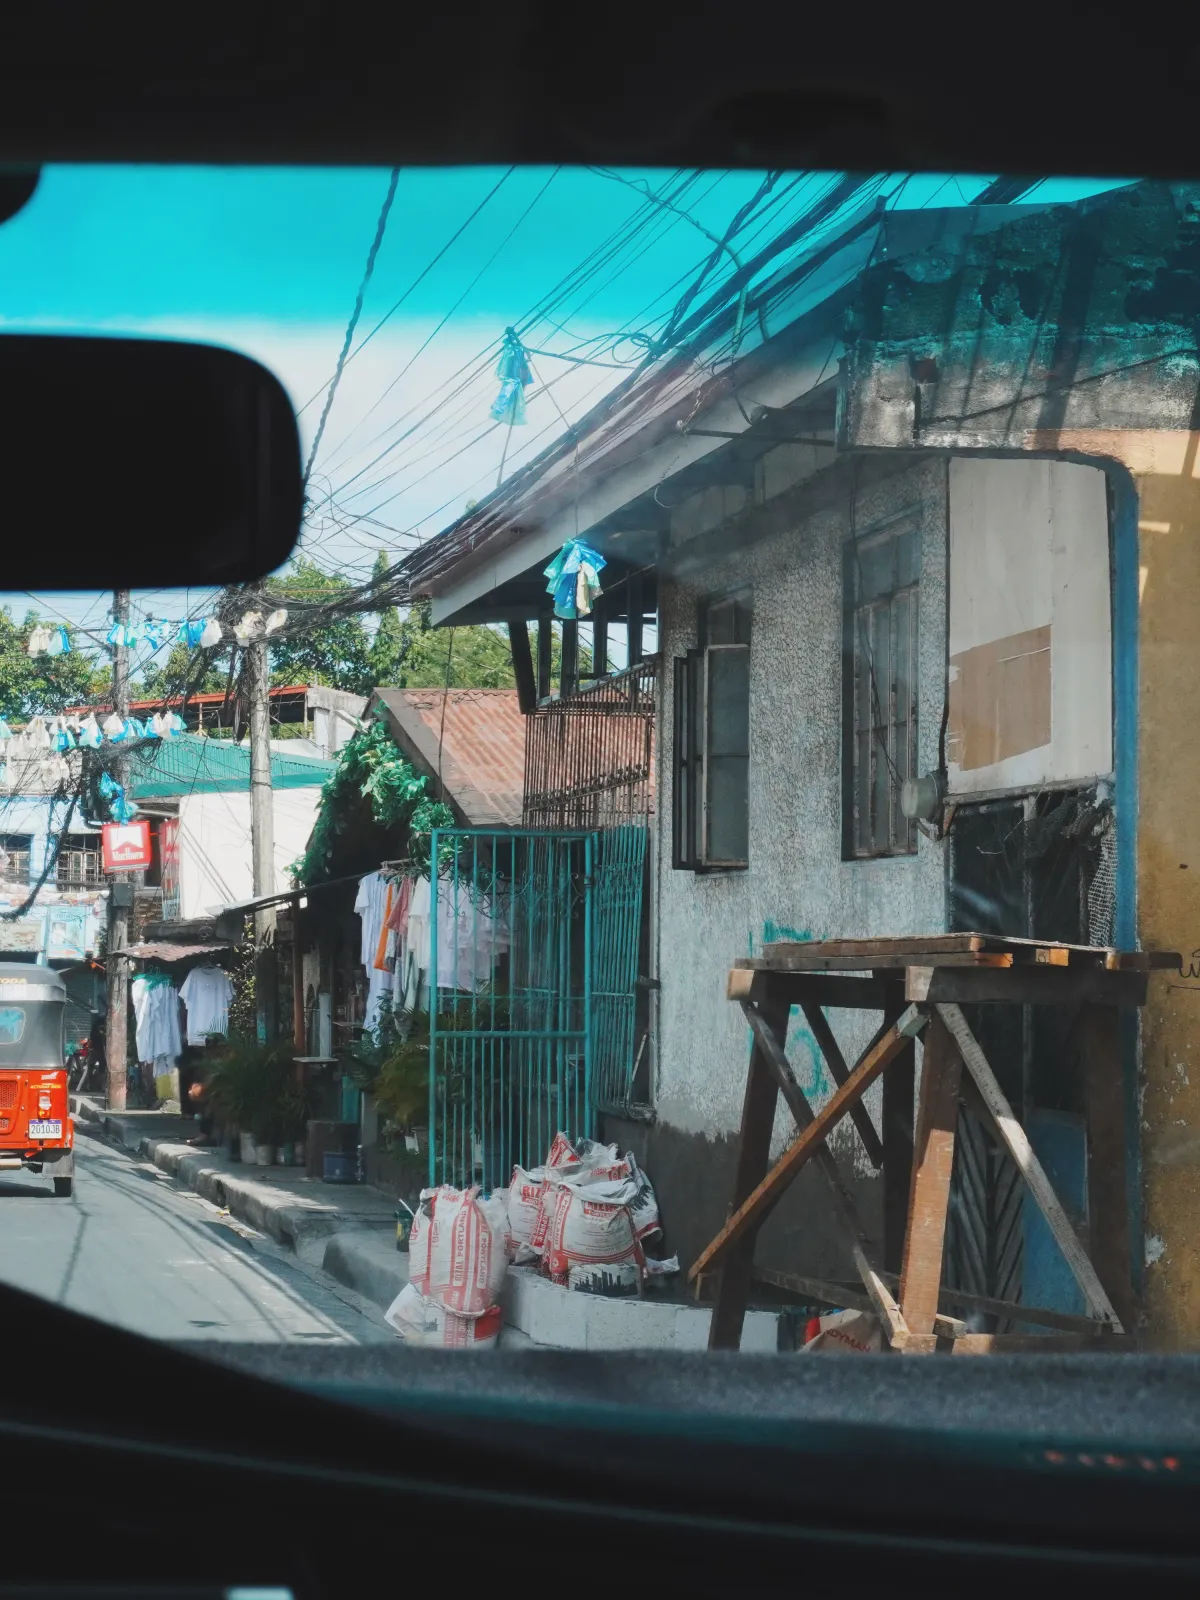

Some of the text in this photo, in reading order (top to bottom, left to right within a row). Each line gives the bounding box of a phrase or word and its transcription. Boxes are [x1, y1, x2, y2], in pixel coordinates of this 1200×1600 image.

[31, 1124, 60, 1134] 2010JB
[522, 1185, 542, 1198] RIZ
[455, 1210, 467, 1257] PORTLAND
